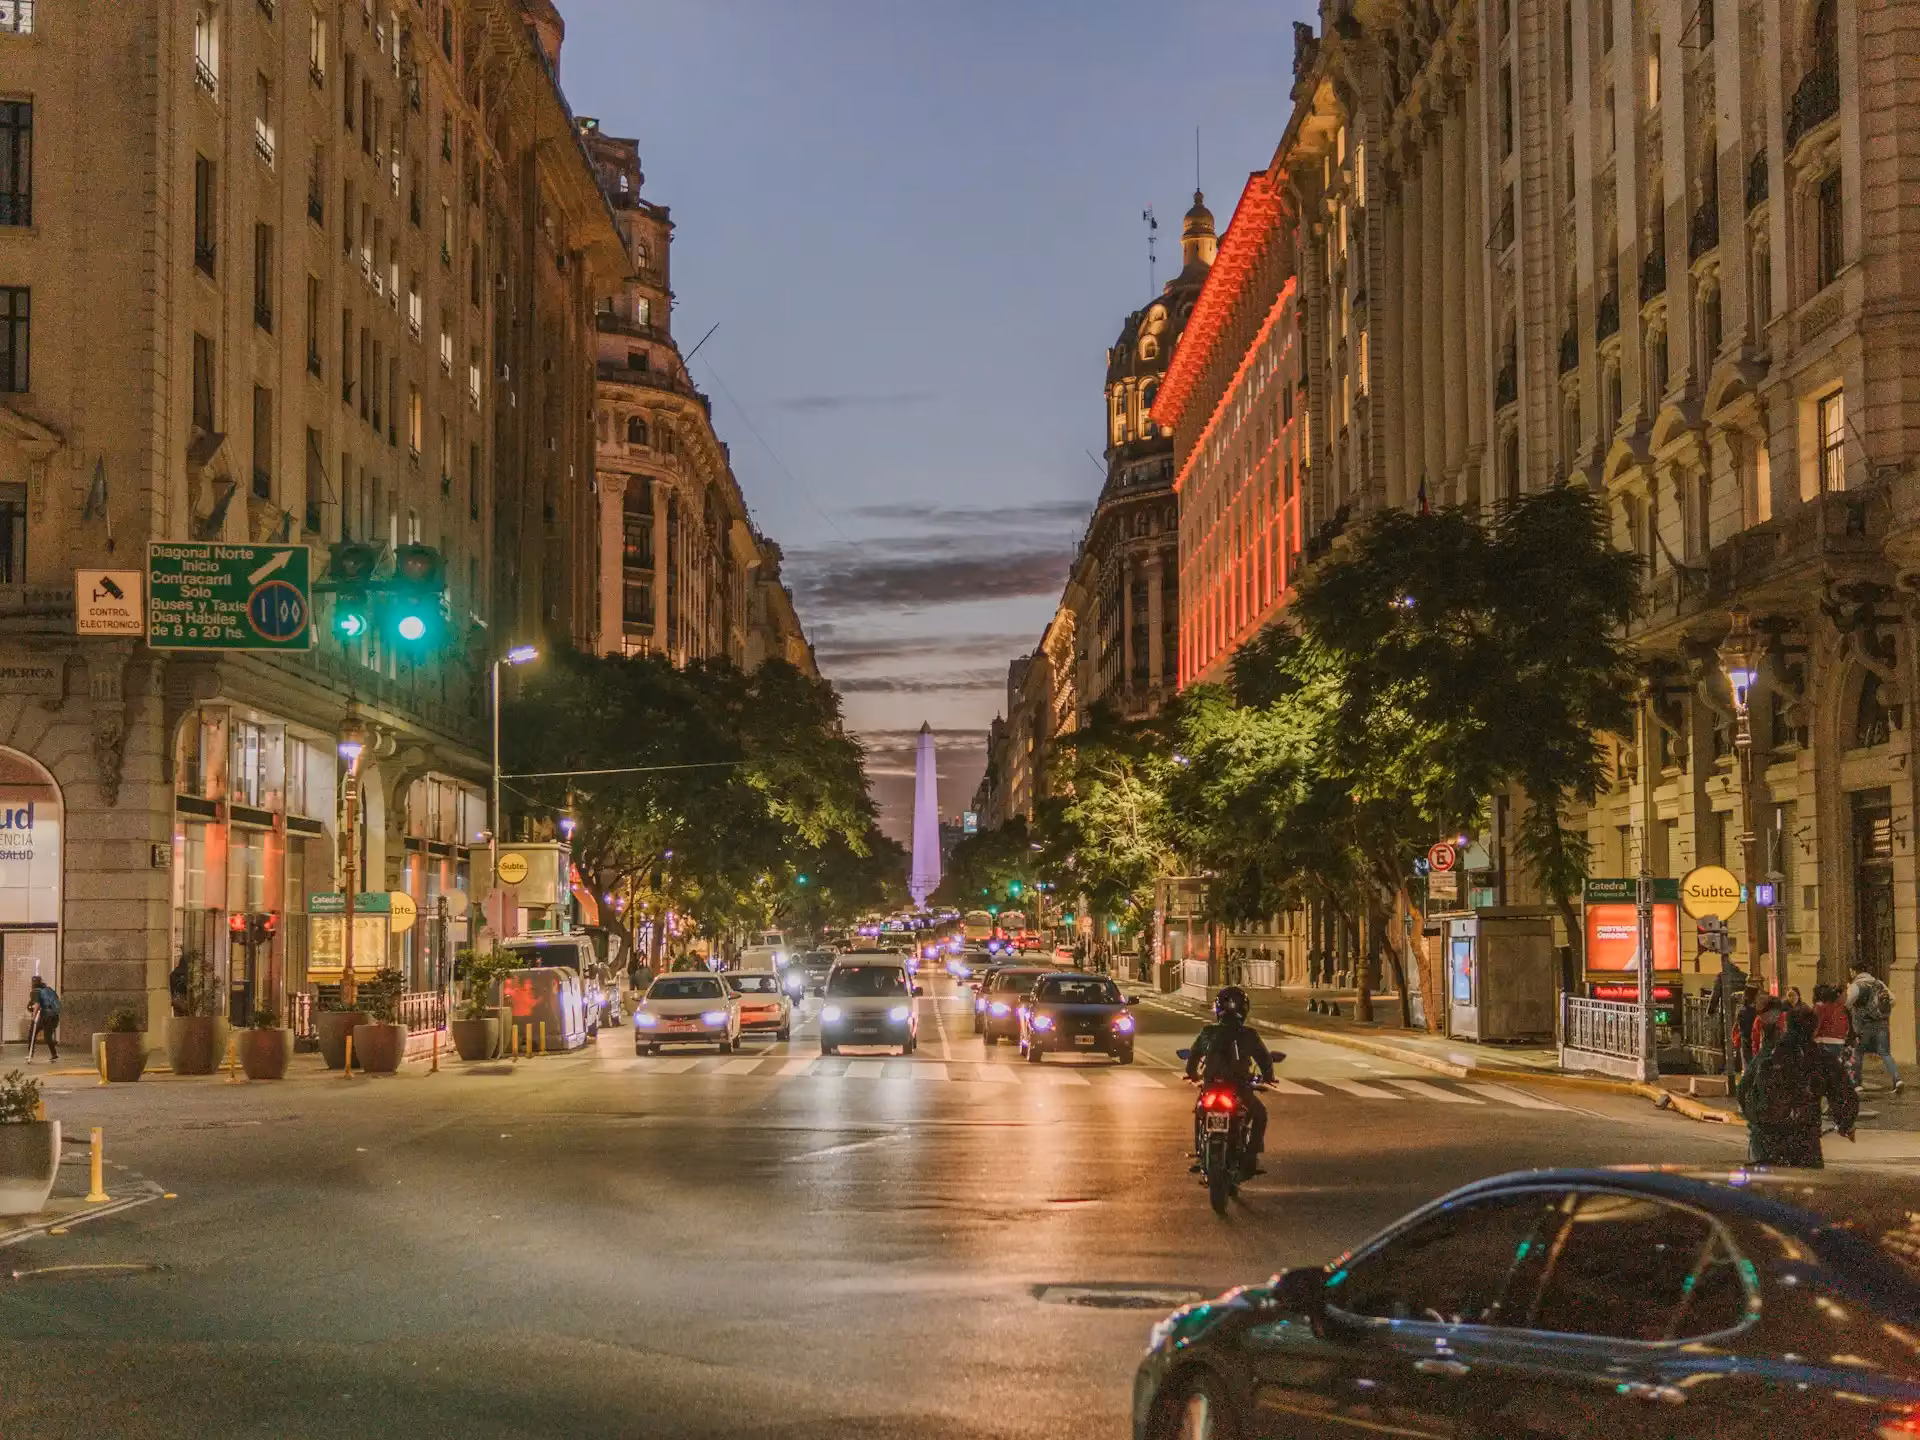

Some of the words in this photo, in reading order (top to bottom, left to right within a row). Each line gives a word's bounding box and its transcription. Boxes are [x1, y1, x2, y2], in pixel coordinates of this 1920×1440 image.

[151, 544, 210, 560] Diagonal
[214, 546, 254, 559] Norte
[183, 559, 219, 572] Inicio
[151, 570, 232, 585] Contracarril
[180, 584, 212, 598] Solo
[151, 597, 194, 610] Buses
[198, 601, 206, 613] y
[211, 599, 249, 612] Taxis
[89, 607, 130, 617] CONTROL
[80, 619, 140, 629] ELECTRONICO
[151, 623, 168, 636] de
[174, 624, 183, 636] 8
[188, 627, 198, 637] a
[202, 625, 221, 638] 20
[225, 625, 246, 639] hs.
[502, 862, 525, 870] Subte
[1589, 881, 1627, 891] Catedral
[1691, 884, 1733, 898] Subte
[311, 895, 345, 904] Catedra
